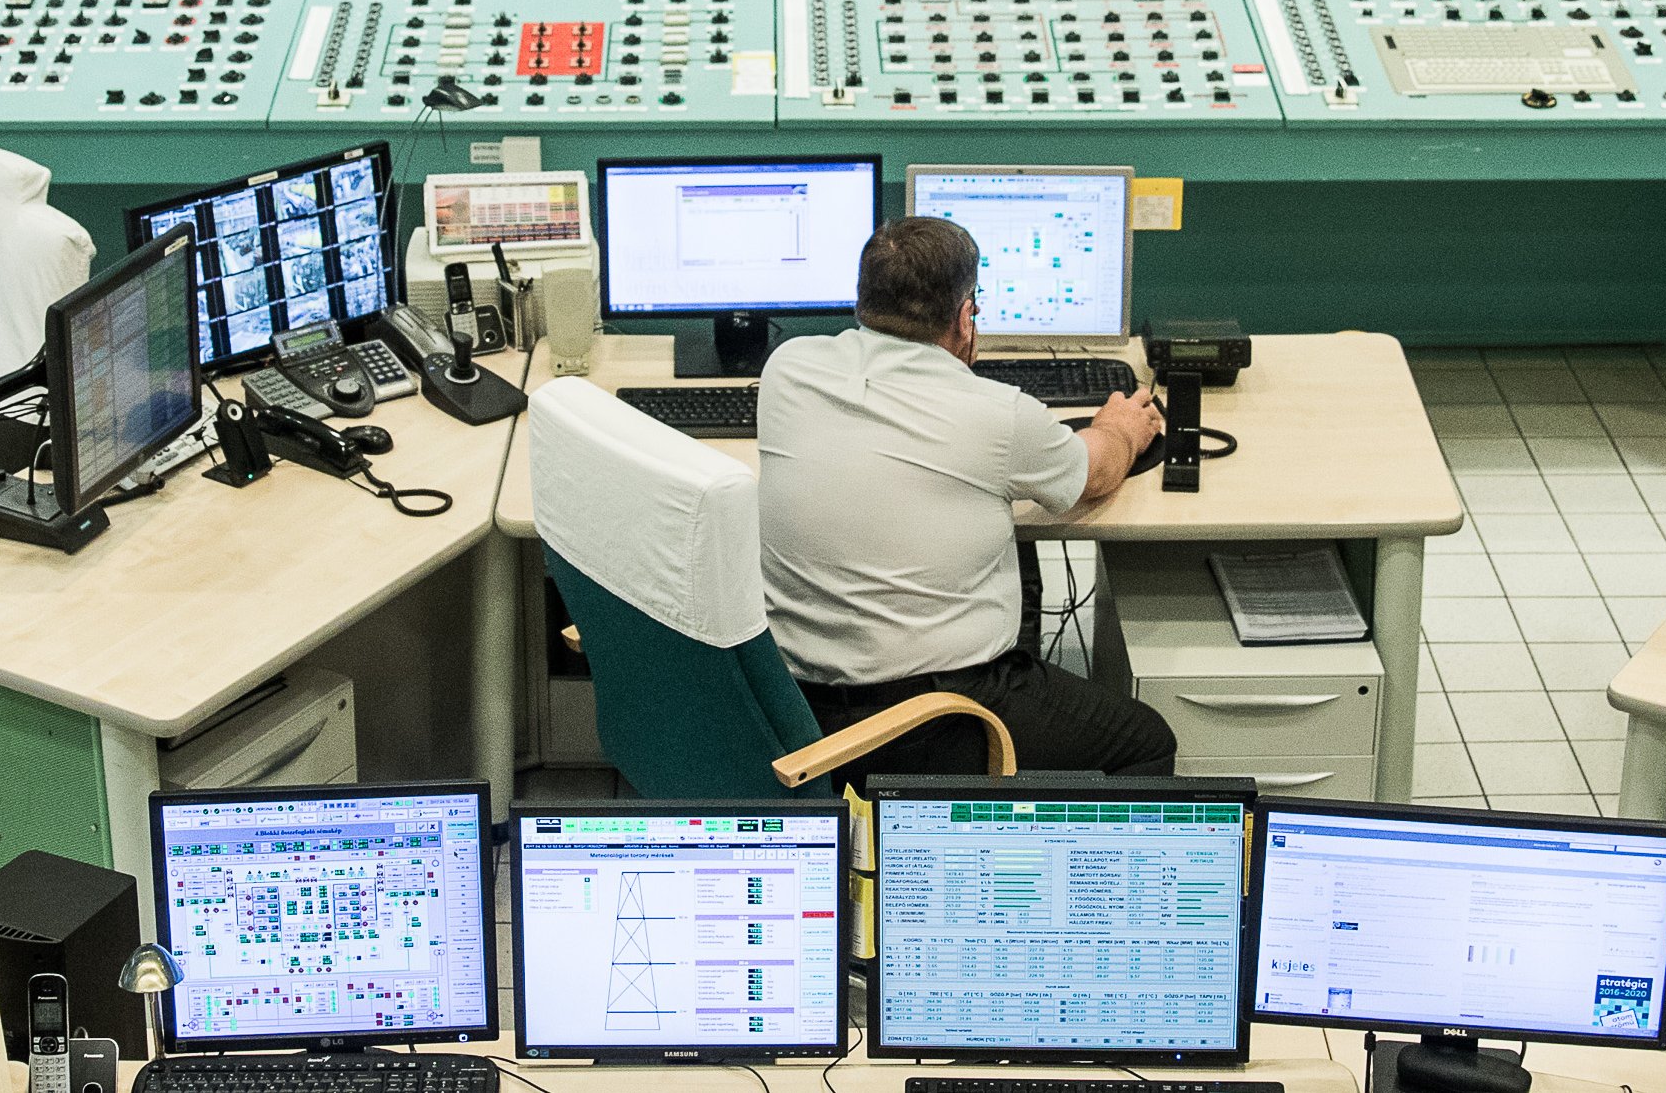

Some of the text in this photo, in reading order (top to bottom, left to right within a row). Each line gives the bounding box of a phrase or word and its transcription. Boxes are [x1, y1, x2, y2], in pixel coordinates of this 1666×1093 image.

[1272, 959, 1315, 972] kisjeles
[1600, 978, 1648, 990] stratégia
[1599, 988, 1647, 998] 2016-2020
[1612, 1013, 1633, 1023] atom
[1443, 1028, 1467, 1037] DELL
